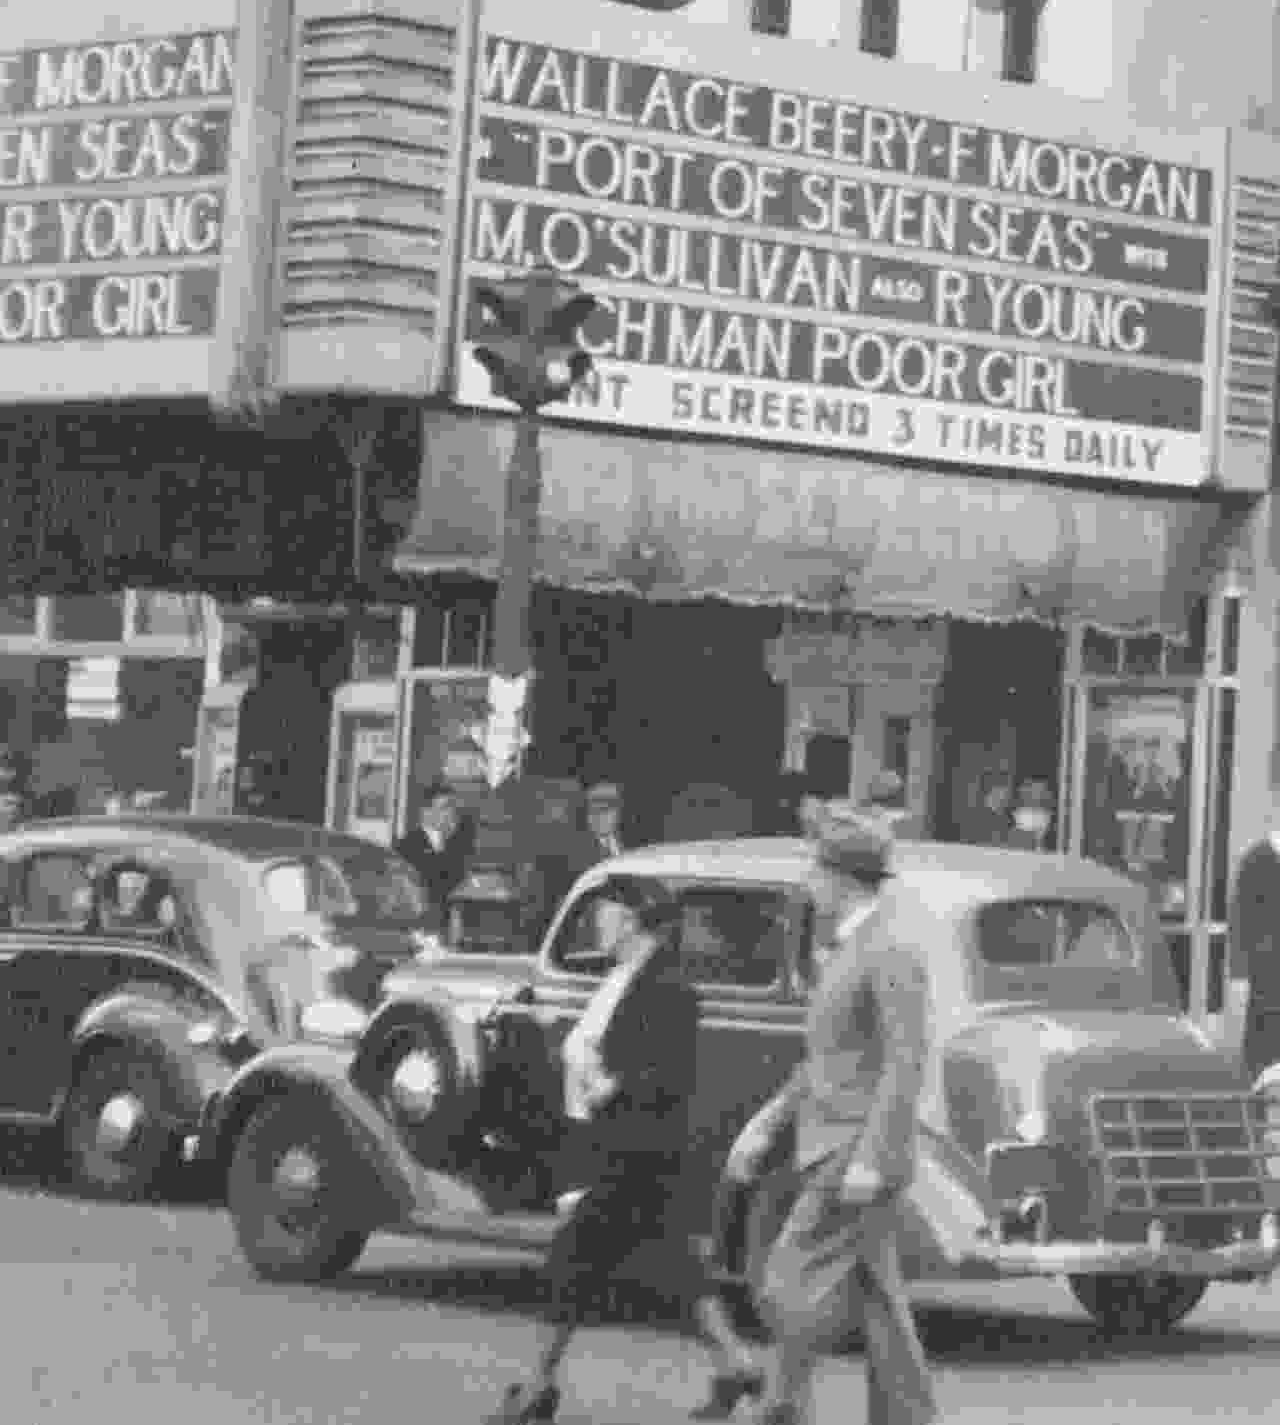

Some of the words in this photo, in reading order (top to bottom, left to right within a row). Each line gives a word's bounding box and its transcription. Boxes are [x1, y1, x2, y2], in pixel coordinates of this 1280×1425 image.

[34, 36, 233, 109] MORGAN
[481, 40, 753, 143] WALLACE
[990, 135, 1198, 222] MORGAN
[58, 192, 219, 263] YOUNG
[710, 159, 785, 223] OF
[801, 173, 956, 251] SEVEN
[93, 275, 193, 337] GIRL
[936, 269, 968, 327] R
[985, 275, 1147, 352] YOUNG
[668, 303, 793, 377] MAN
[812, 326, 968, 403] POOR
[977, 350, 1080, 418] GIRL
[888, 406, 915, 447] 3
[936, 413, 1046, 463] TIMES
[1063, 430, 1167, 472] DAILY
